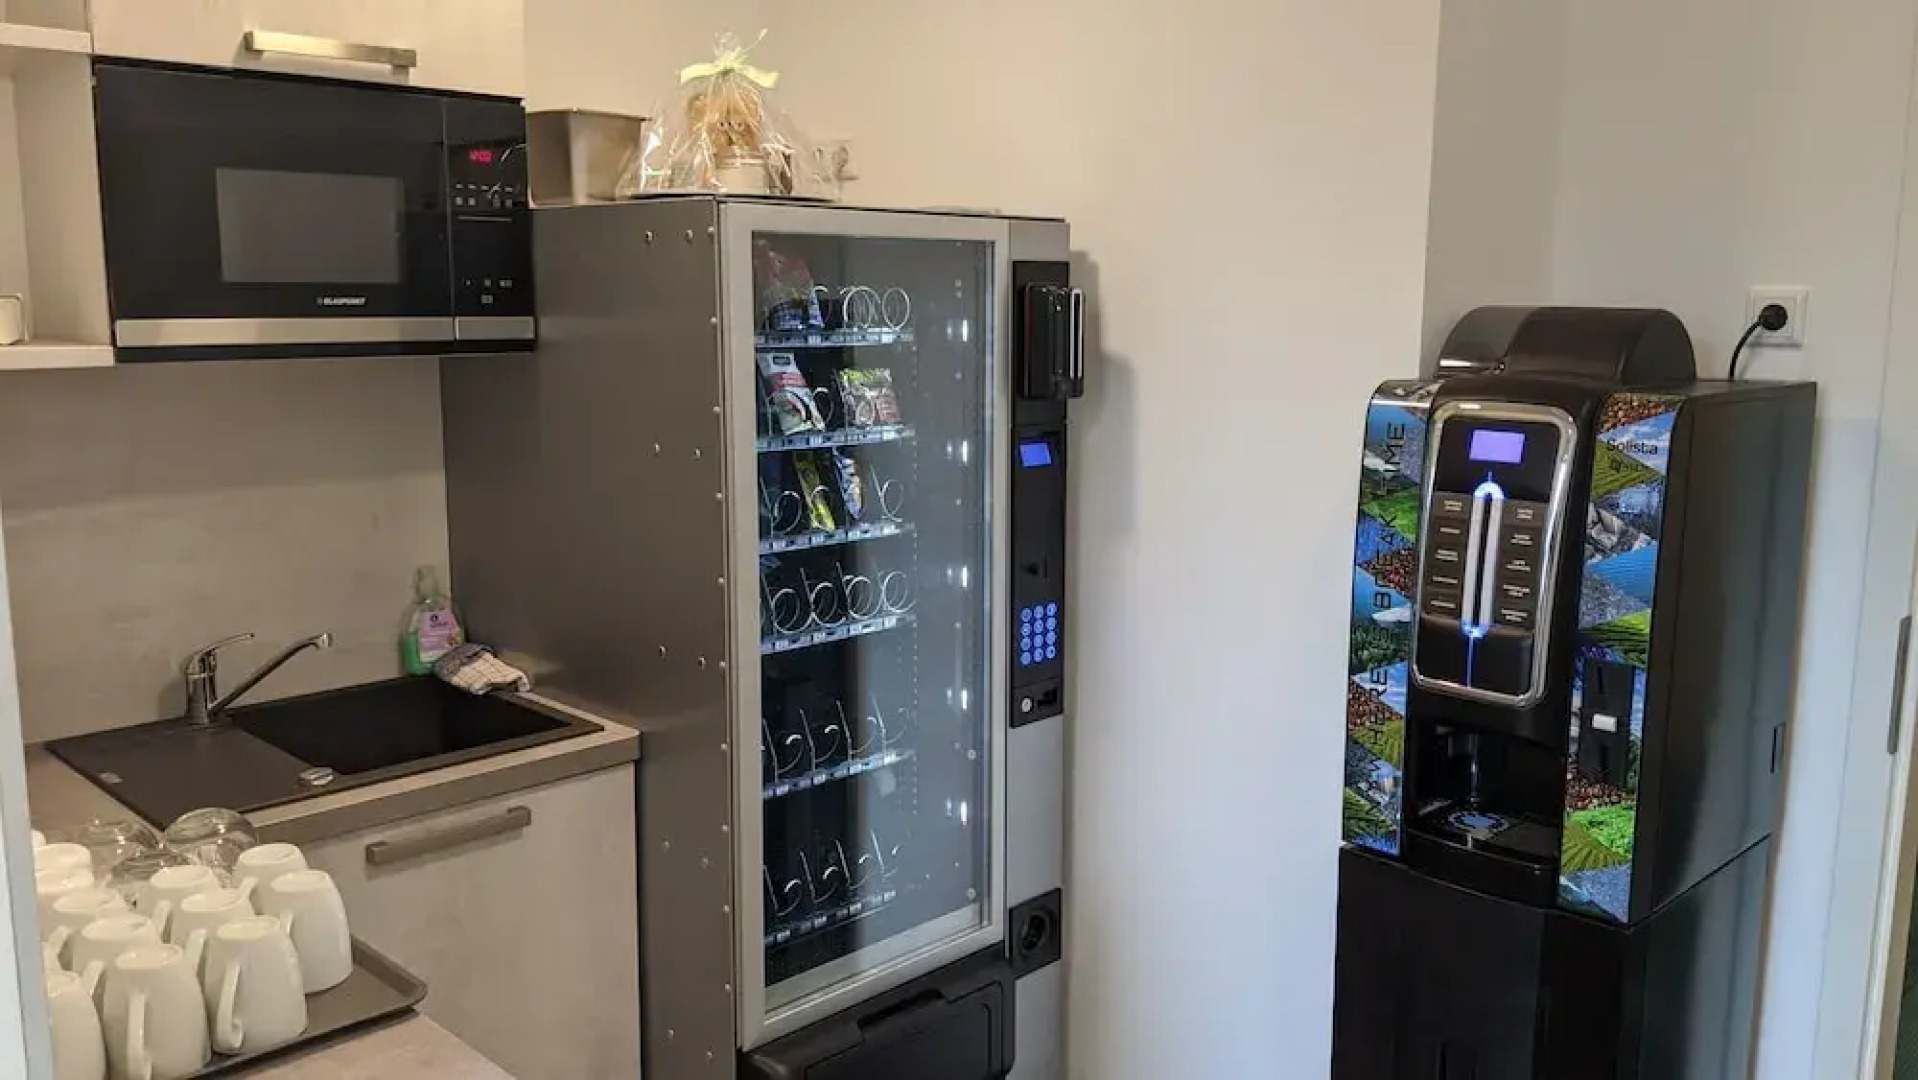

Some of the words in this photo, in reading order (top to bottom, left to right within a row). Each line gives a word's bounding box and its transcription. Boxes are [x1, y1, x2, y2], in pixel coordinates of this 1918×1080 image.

[1376, 421, 1406, 496] TIME
[1606, 436, 1658, 455] Solista
[1372, 514, 1397, 609] BREAK
